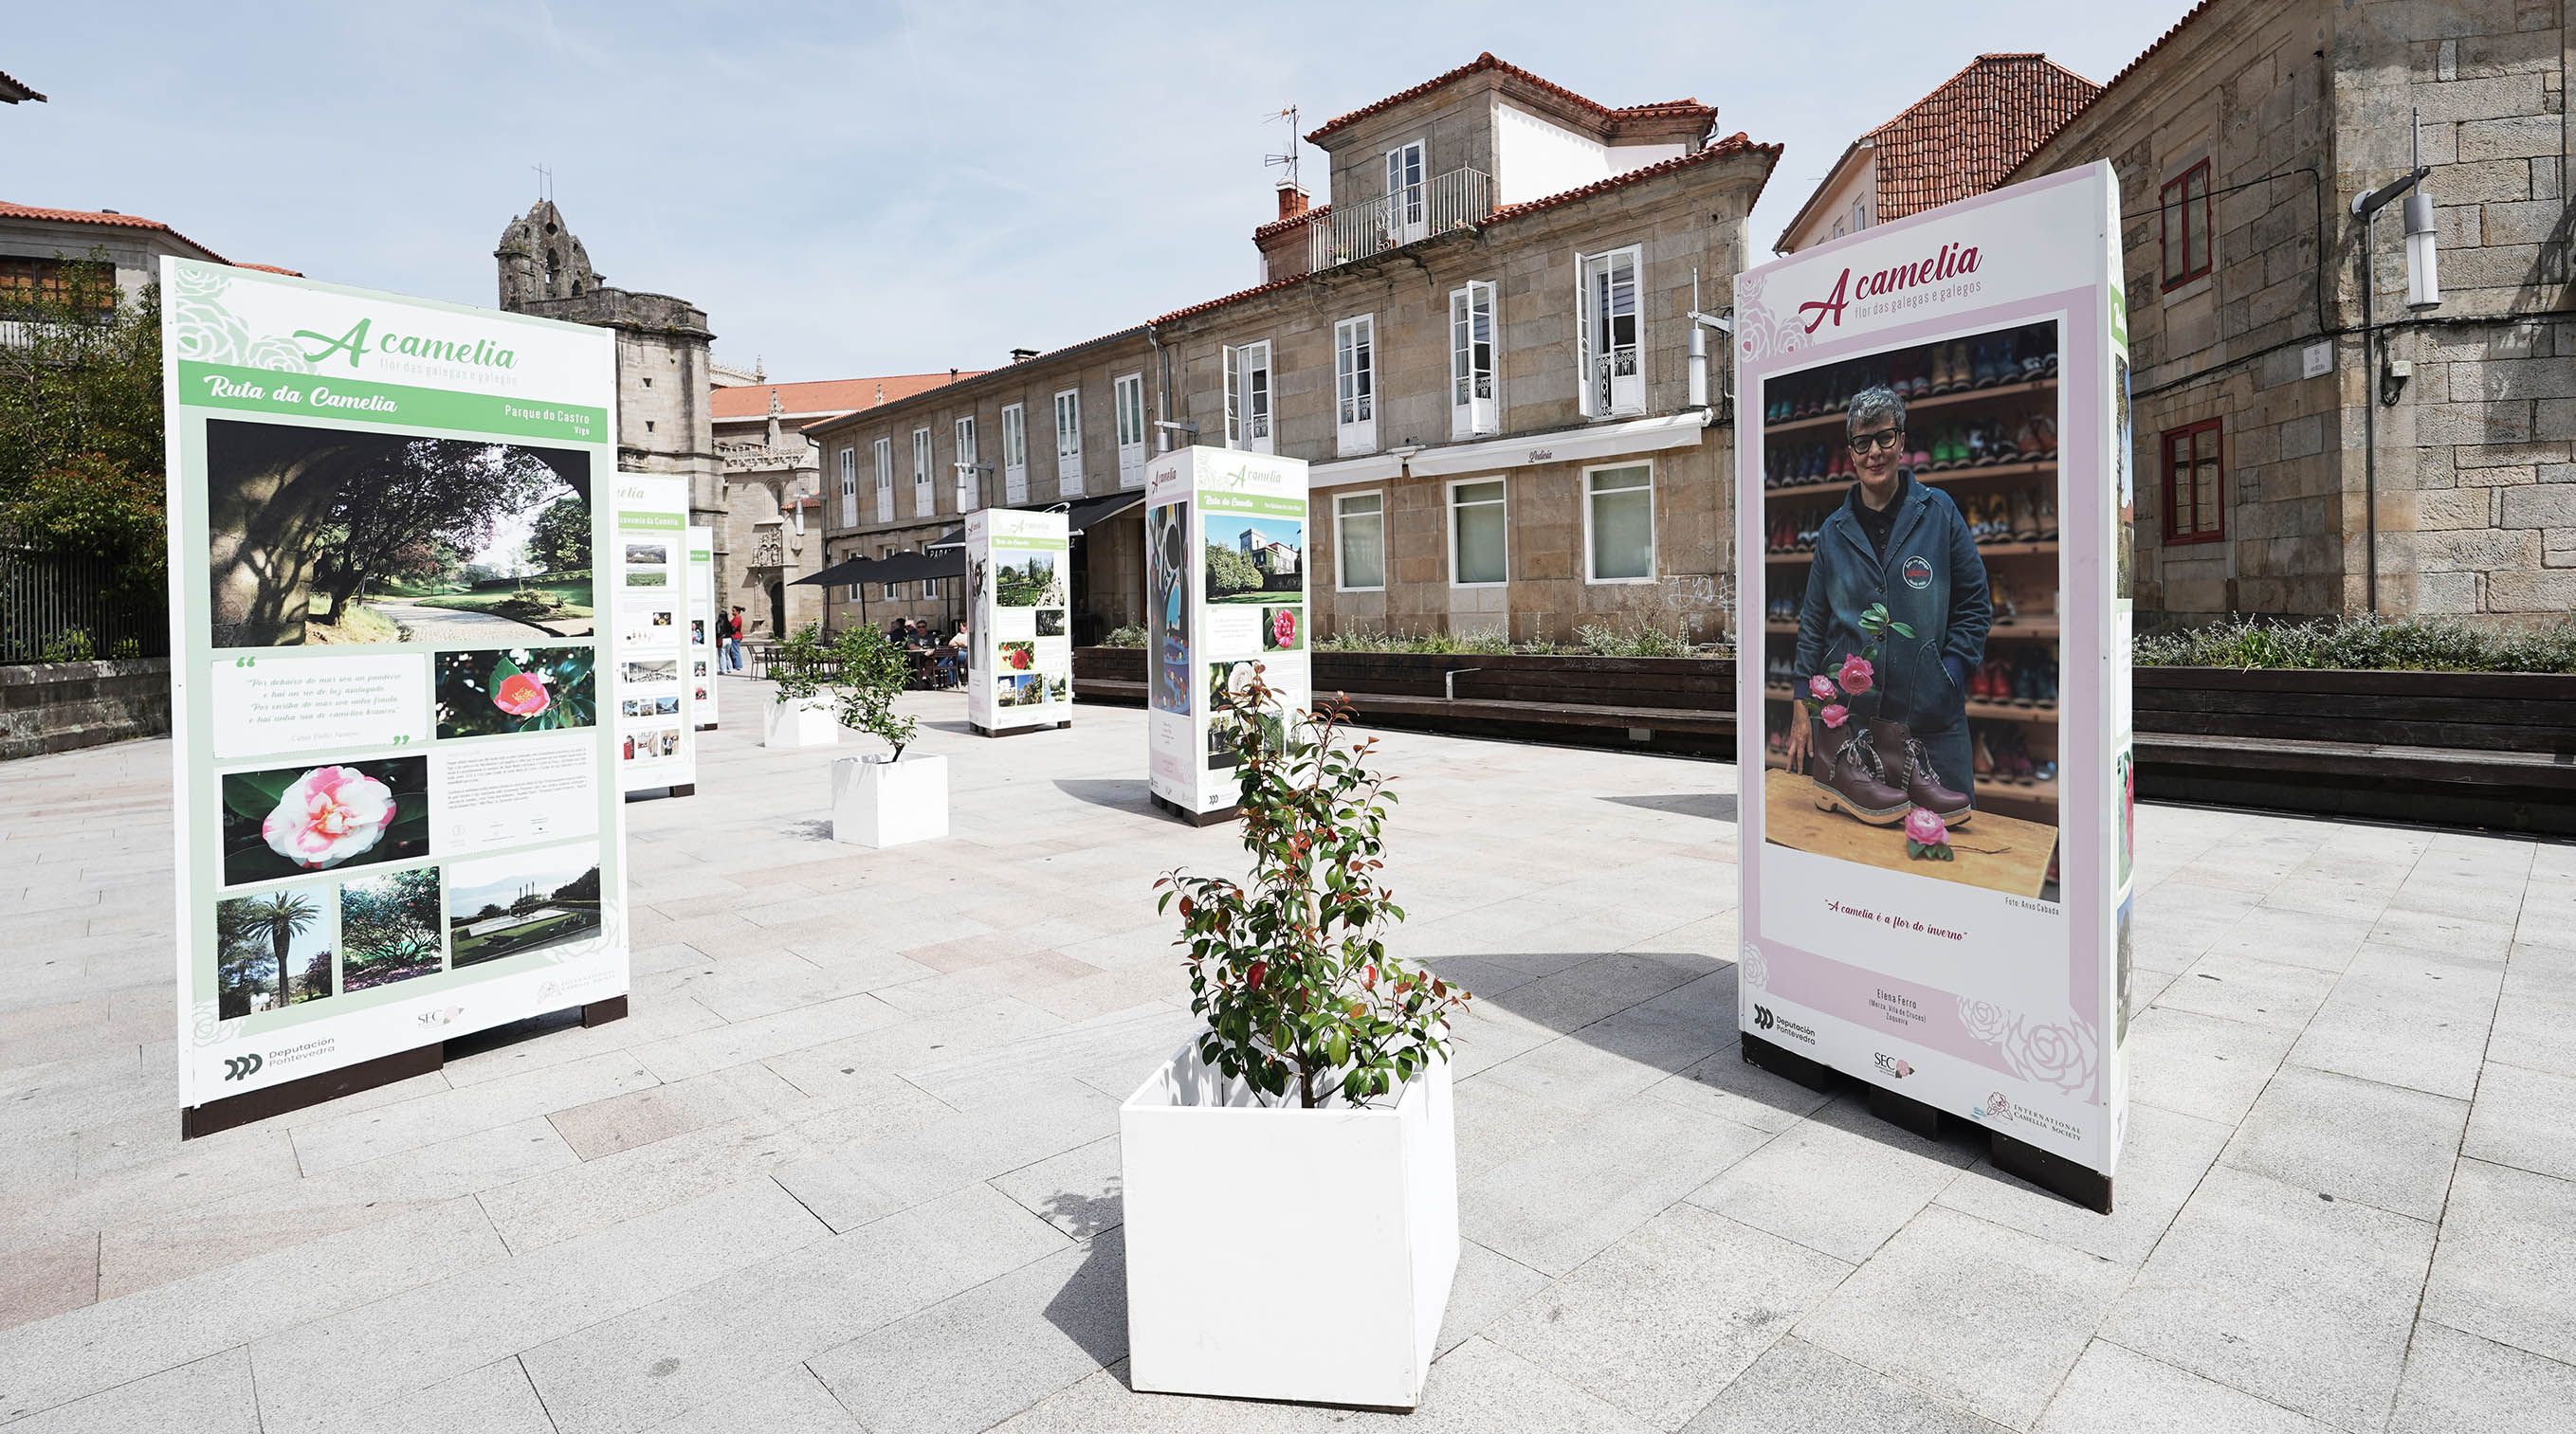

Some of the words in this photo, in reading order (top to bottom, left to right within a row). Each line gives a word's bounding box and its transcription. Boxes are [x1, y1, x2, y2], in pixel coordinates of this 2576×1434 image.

[1799, 268, 1850, 334] A
[1855, 243, 1982, 300] camelia
[1854, 306, 1872, 318] flor
[1873, 302, 1889, 315] das
[1891, 293, 1928, 313] galegas
[1932, 291, 1937, 301] e
[1940, 281, 1982, 302] galegos
[292, 318, 372, 369] A
[380, 334, 519, 370] camelia
[203, 375, 265, 400] Ruta
[273, 387, 303, 404] da
[309, 386, 398, 413] Camelia
[504, 404, 540, 421] Parque
[544, 409, 555, 421] do
[557, 410, 590, 425] Castro
[575, 426, 590, 436] Vigo
[1227, 464, 1246, 487] A
[1248, 470, 1282, 483] camelia
[618, 486, 645, 499] elia
[2021, 900, 2036, 910] Anxo
[2037, 903, 2059, 916] Cabada
[1841, 905, 1873, 920] camelia
[1876, 912, 1882, 921] é
[1885, 916, 1891, 924] a
[1892, 916, 1909, 929] flor
[1912, 921, 1924, 933] do
[1877, 989, 1896, 1003] Elena
[1898, 994, 1917, 1009] Ferro
[1777, 1016, 1816, 1037] Deputación
[1777, 1024, 1816, 1044] Pontevedra
[269, 1037, 335, 1059] Deputación
[269, 1046, 335, 1067] Pontevedra
[1874, 1052, 1895, 1070] SEC
[2014, 1104, 2081, 1134] INTERNATIONAL
[2014, 1112, 2047, 1129] CAMELLIA
[2052, 1126, 2081, 1141] SOCIETY
